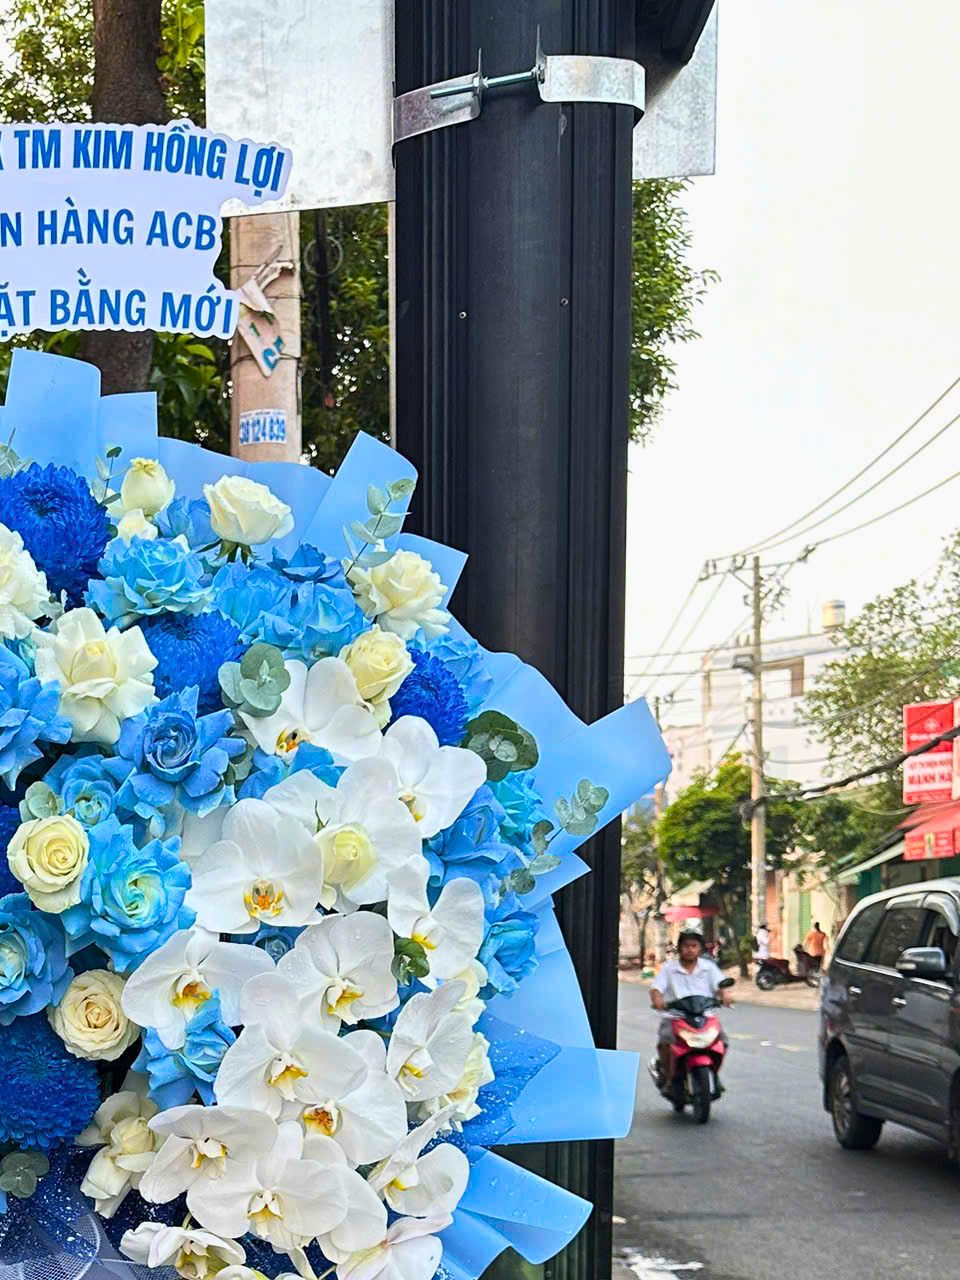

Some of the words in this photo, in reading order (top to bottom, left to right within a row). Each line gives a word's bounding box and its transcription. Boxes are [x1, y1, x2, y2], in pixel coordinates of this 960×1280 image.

[14, 129, 62, 170] TM
[73, 129, 134, 170] KIM
[143, 124, 227, 180] HỒNG
[234, 143, 286, 198] LỢI
[37, 196, 134, 246] HÀNG
[145, 210, 217, 252] ACB
[50, 267, 146, 326] BẰNG
[160, 284, 234, 334] MỚI
